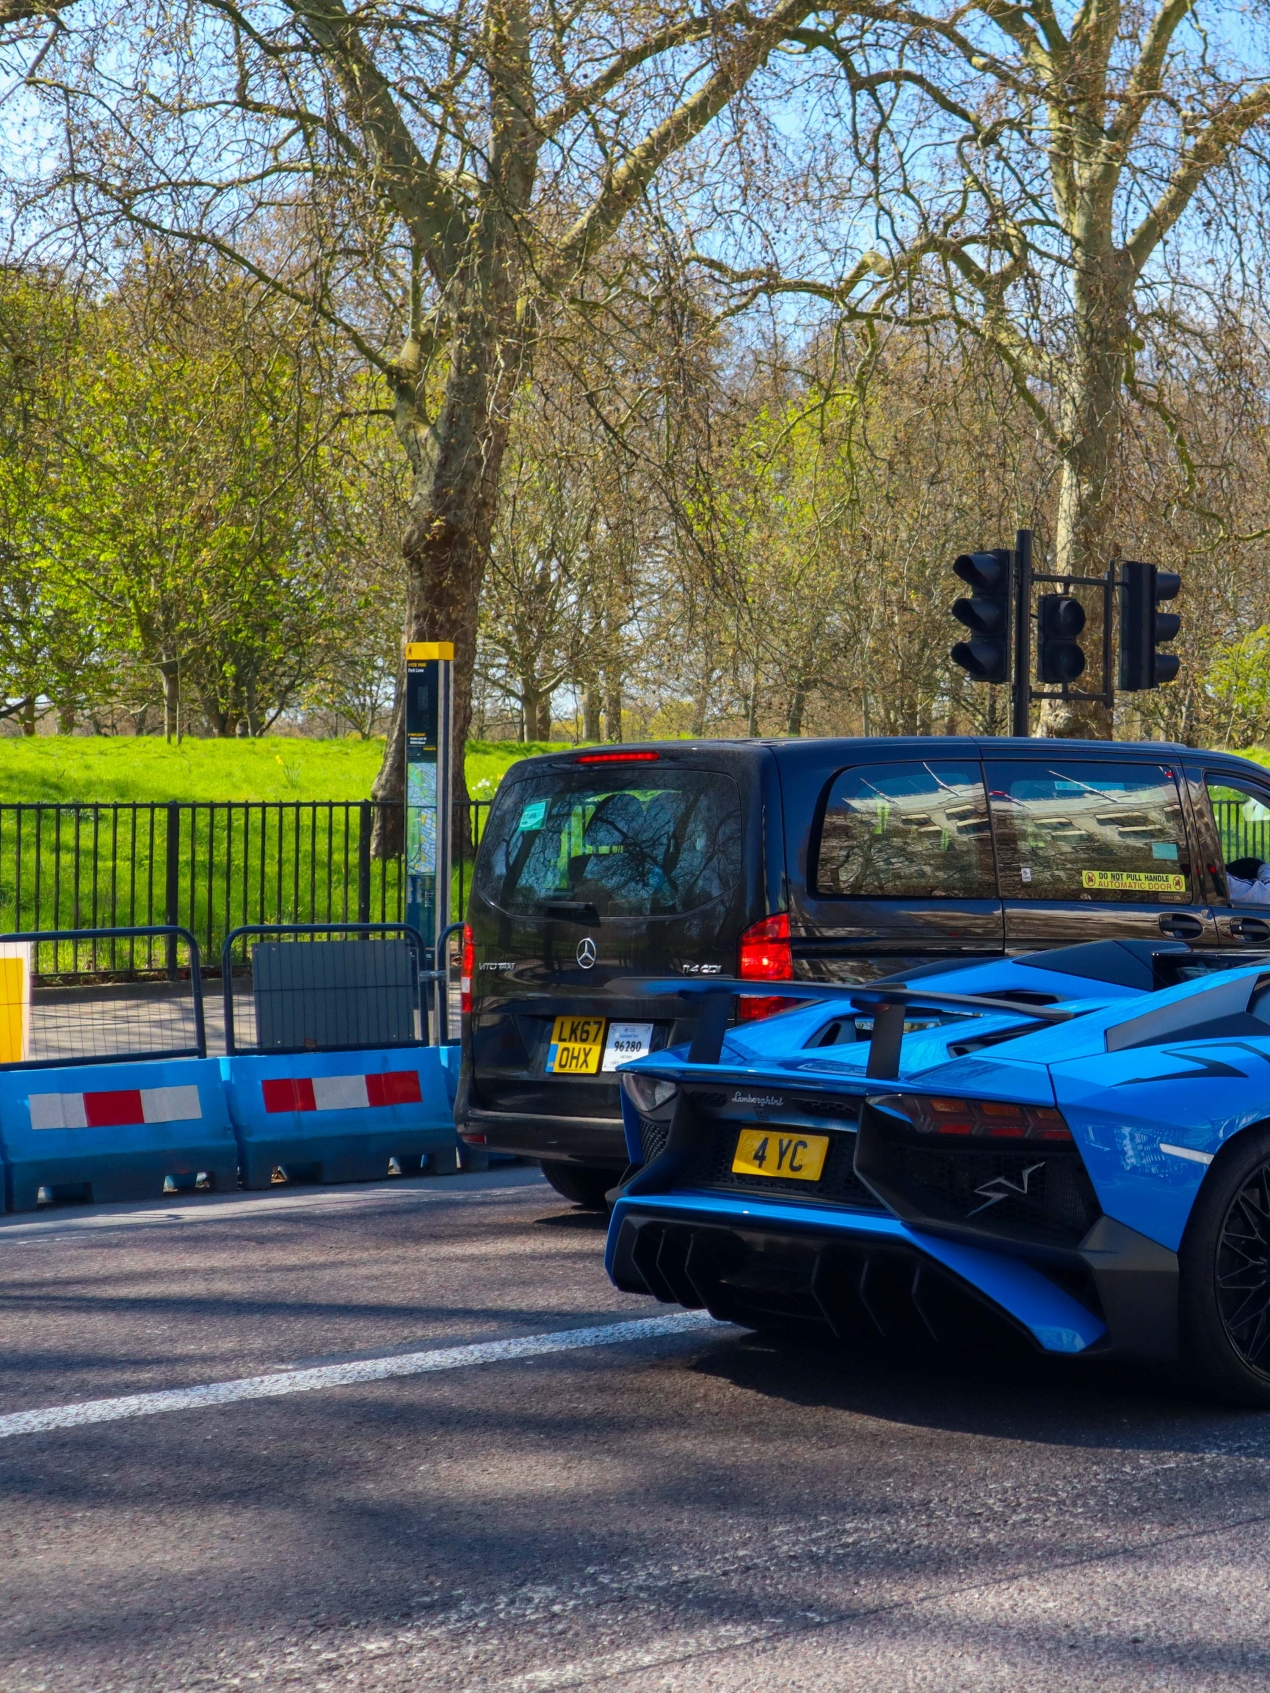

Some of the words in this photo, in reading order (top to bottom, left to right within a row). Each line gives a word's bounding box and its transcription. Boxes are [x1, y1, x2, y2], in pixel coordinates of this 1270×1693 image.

[1099, 872, 1108, 880] DO
[1111, 872, 1124, 881] NOT
[1126, 873, 1142, 882] PULL
[1144, 874, 1170, 883] HANDLE
[1098, 880, 1146, 890] AUTOMATIC
[1148, 882, 1172, 891] DOOR
[478, 962, 497, 971] VITO
[497, 962, 516, 971] TAXI
[557, 1020, 603, 1043] LK67
[614, 1040, 642, 1053] 96280
[558, 1046, 593, 1069] OHX
[731, 1091, 784, 1107] Lamborghini
[752, 1136, 770, 1169] 4
[776, 1138, 809, 1173] YC
